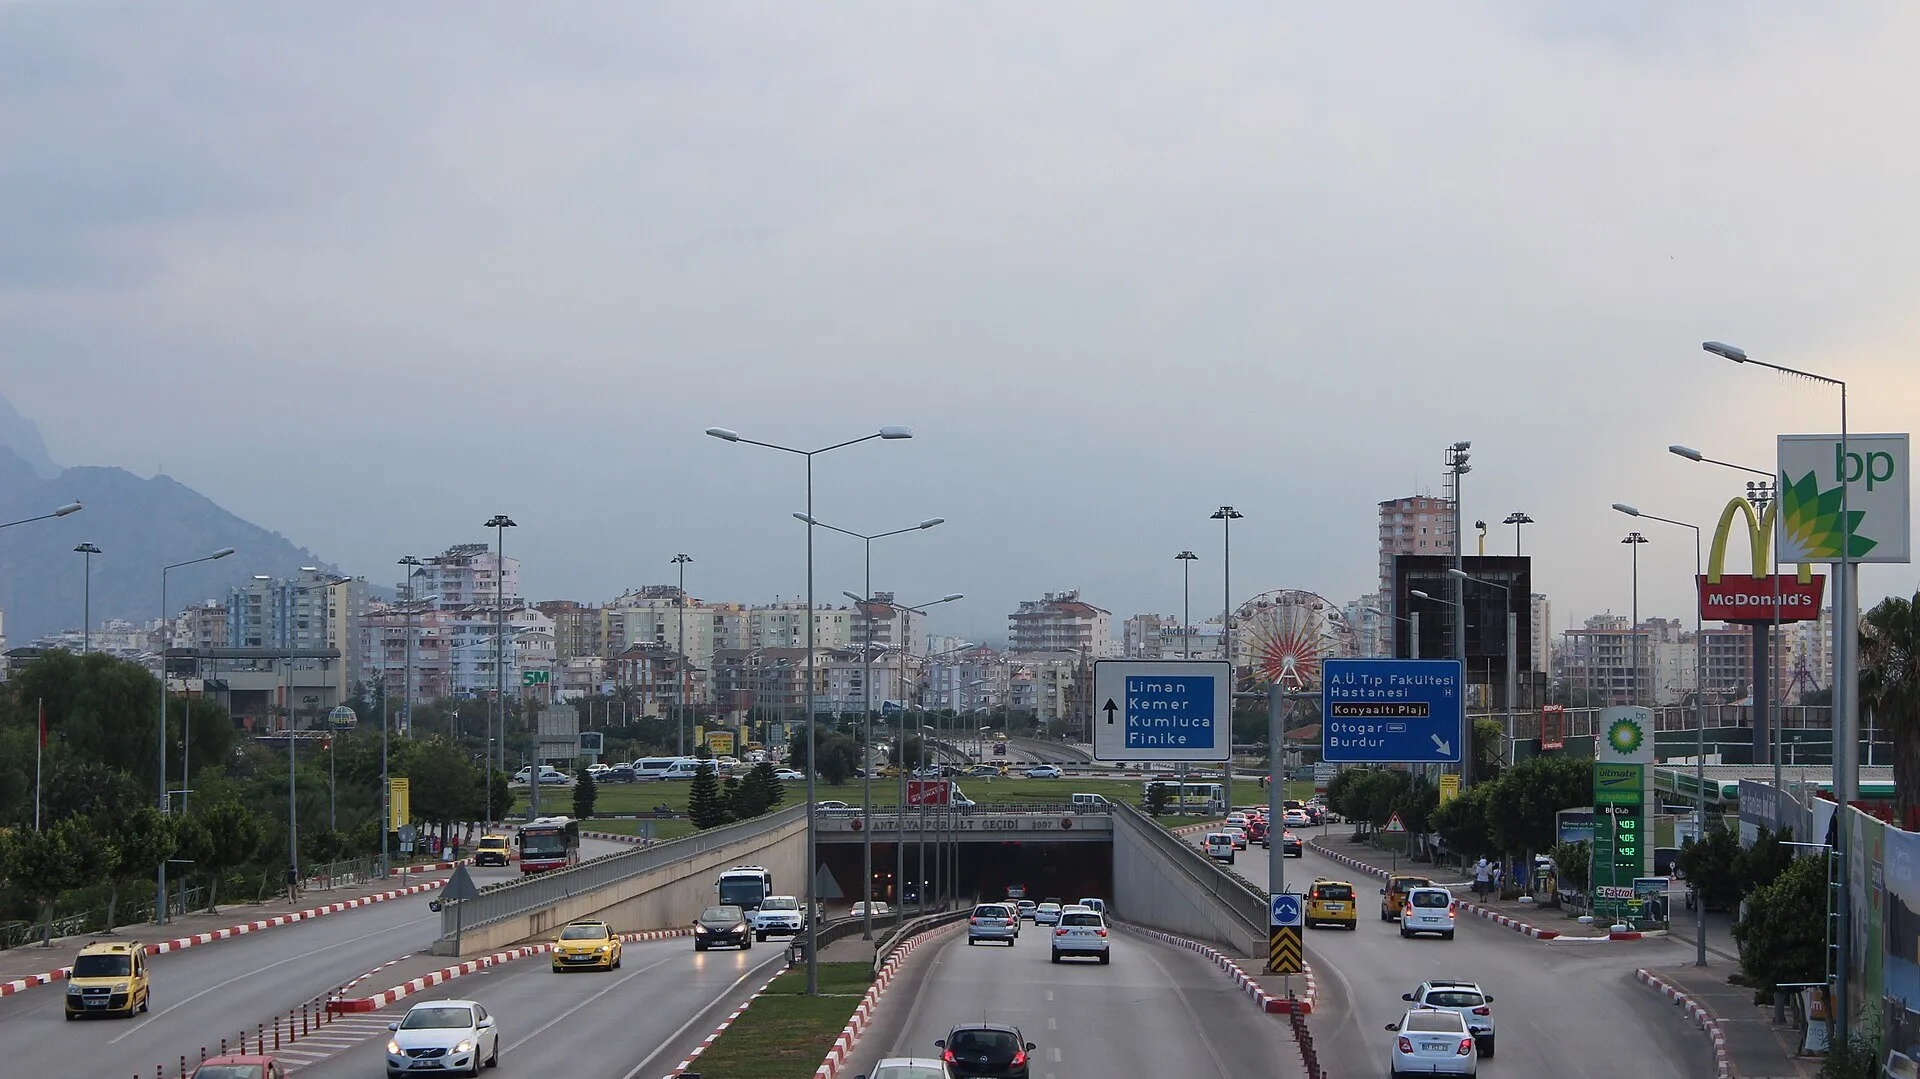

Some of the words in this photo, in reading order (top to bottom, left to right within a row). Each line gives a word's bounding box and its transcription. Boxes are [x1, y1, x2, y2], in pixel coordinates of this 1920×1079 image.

[1835, 442, 1895, 491] bp
[1707, 593, 1812, 606] McDonald's
[523, 671, 549, 687] 5M
[1389, 675, 1454, 686] Fakültesi
[1129, 681, 1186, 693] Liman
[1330, 687, 1408, 697] Hastanesi
[1129, 698, 1189, 710] Kemer
[1334, 705, 1395, 716] Konyaaltı
[1398, 705, 1427, 716] Plajı
[1635, 711, 1647, 721] bp
[1129, 715, 1210, 727] Kumluca
[1330, 723, 1383, 735] Otogar
[1129, 732, 1187, 744] Finike
[1330, 737, 1385, 747] Burdur
[1619, 820, 1635, 829] 4.03
[1619, 834, 1635, 842] 4.05
[1619, 847, 1635, 856] 4.92
[1604, 887, 1634, 897] Castrol
